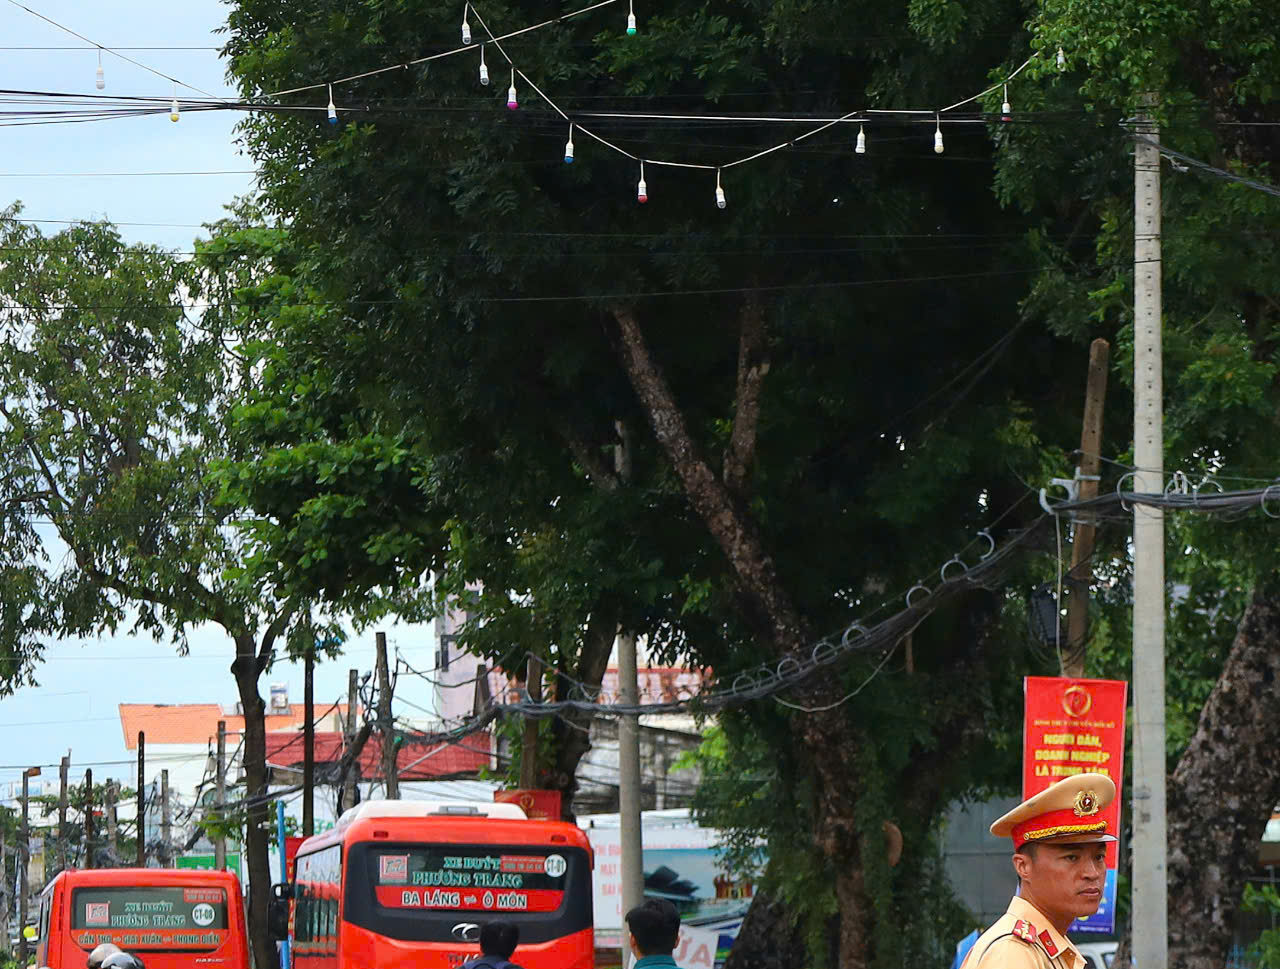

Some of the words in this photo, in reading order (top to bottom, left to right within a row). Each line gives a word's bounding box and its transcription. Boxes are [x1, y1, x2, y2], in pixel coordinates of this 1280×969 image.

[443, 857, 462, 869] XE
[474, 872, 523, 888] TRANG
[402, 891, 420, 905] BA
[424, 888, 460, 907] LÁNG
[482, 891, 494, 908] Ô
[497, 890, 527, 909] MÔN
[152, 914, 186, 927] TRANG
